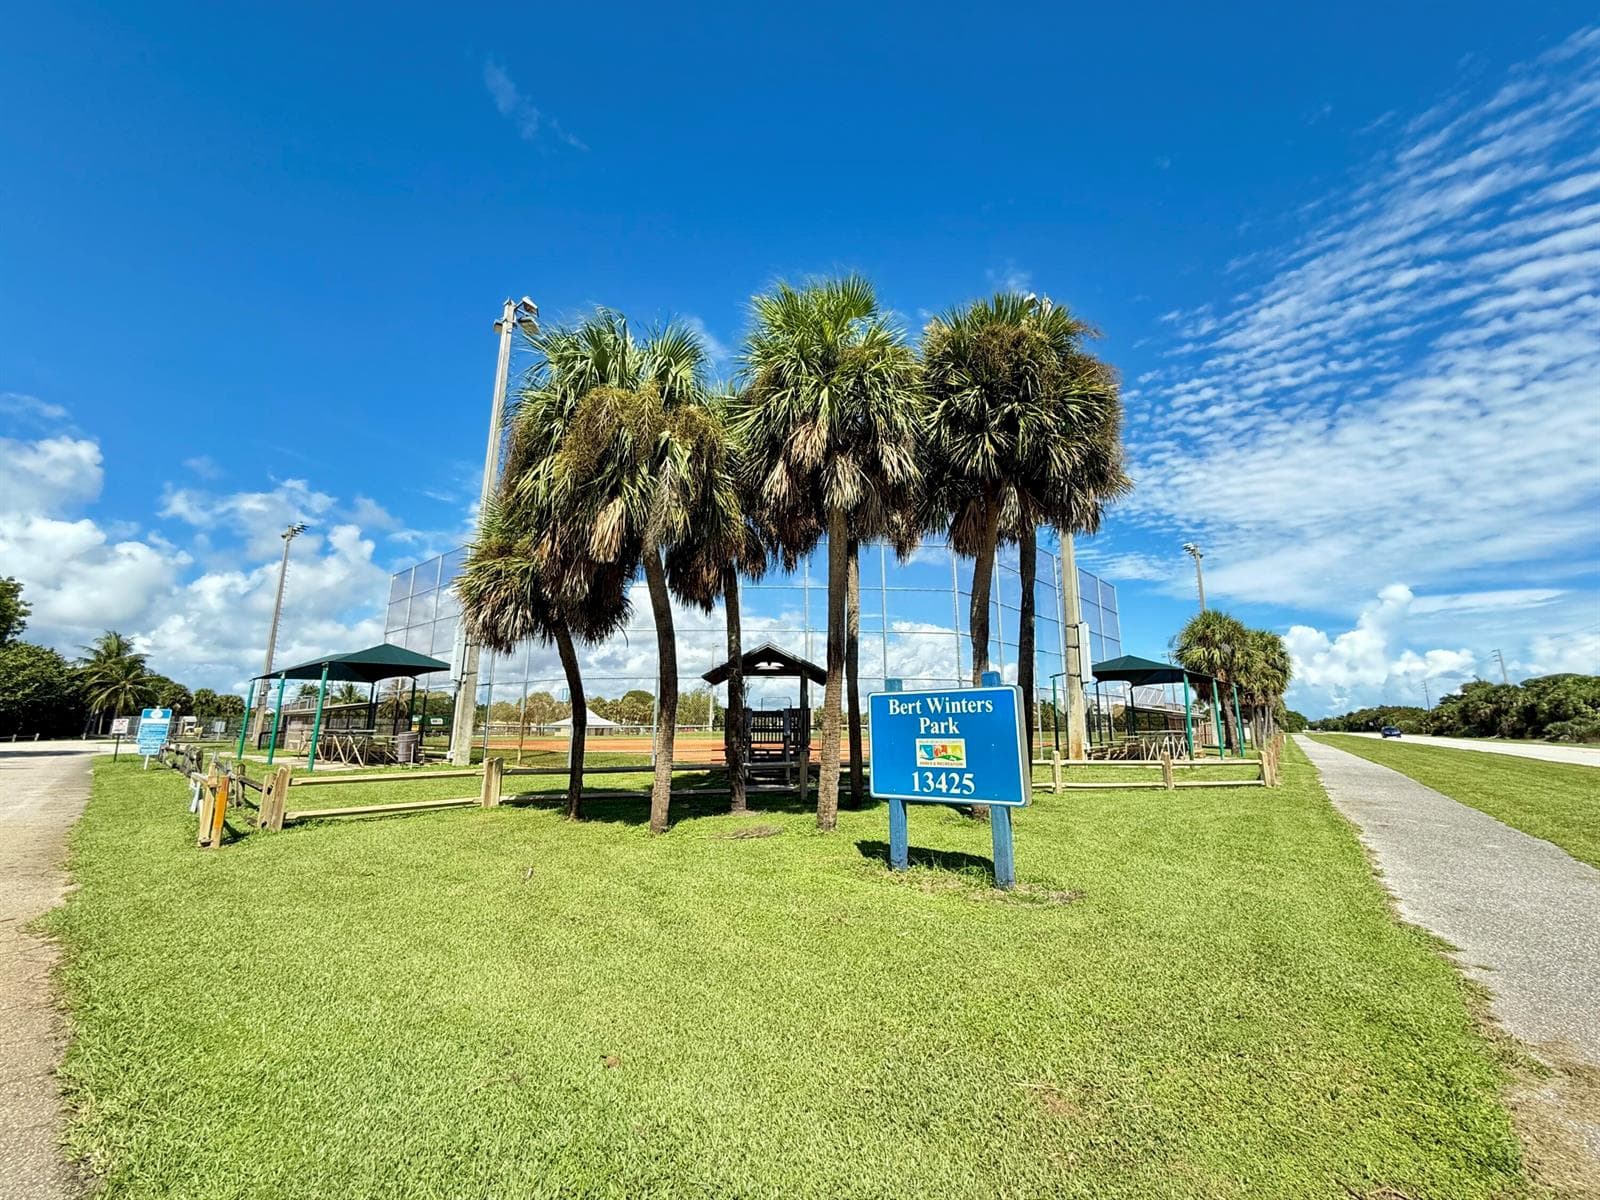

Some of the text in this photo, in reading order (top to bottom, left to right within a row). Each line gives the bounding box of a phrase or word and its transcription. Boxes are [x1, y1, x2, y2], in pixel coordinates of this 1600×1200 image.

[888, 697, 993, 715] Bert Winters
[919, 717, 960, 734] Park
[912, 771, 975, 795] 13425
